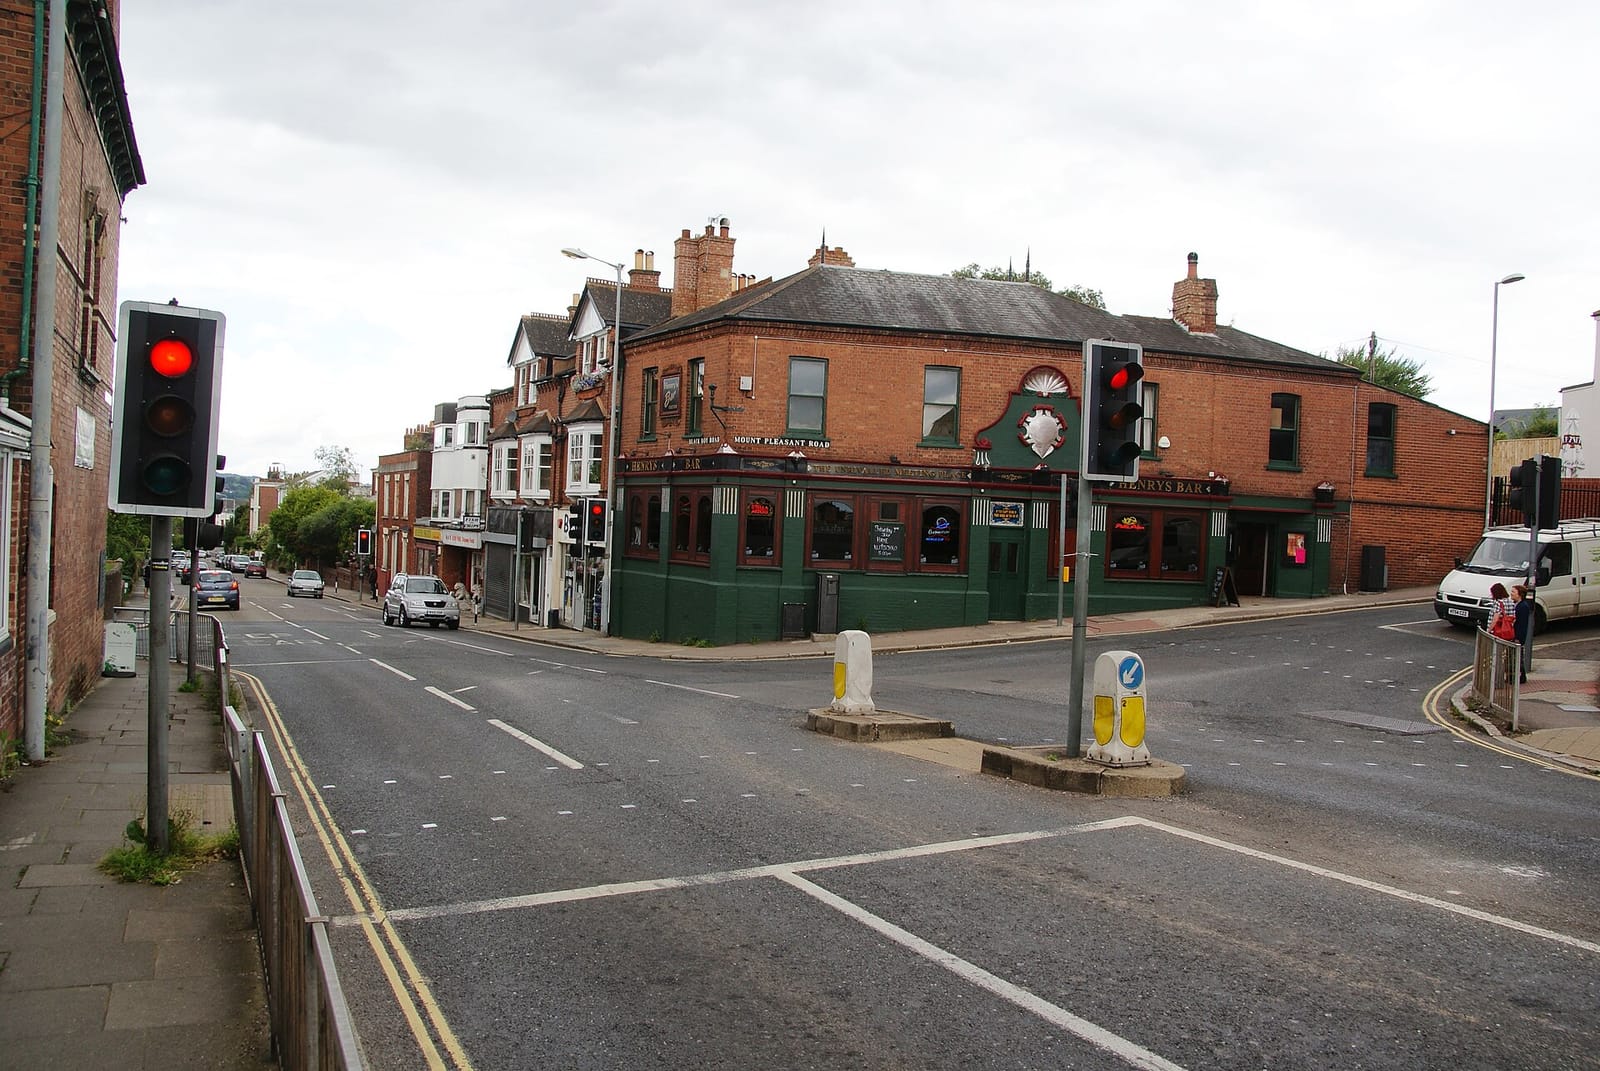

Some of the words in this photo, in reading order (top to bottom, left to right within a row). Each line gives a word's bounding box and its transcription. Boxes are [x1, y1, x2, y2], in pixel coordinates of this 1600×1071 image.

[734, 436, 762, 444] MOUNT
[764, 437, 806, 446] PLEASANT
[808, 440, 830, 448] ROAD
[685, 458, 701, 470] BAR
[1176, 482, 1202, 494] BAR
